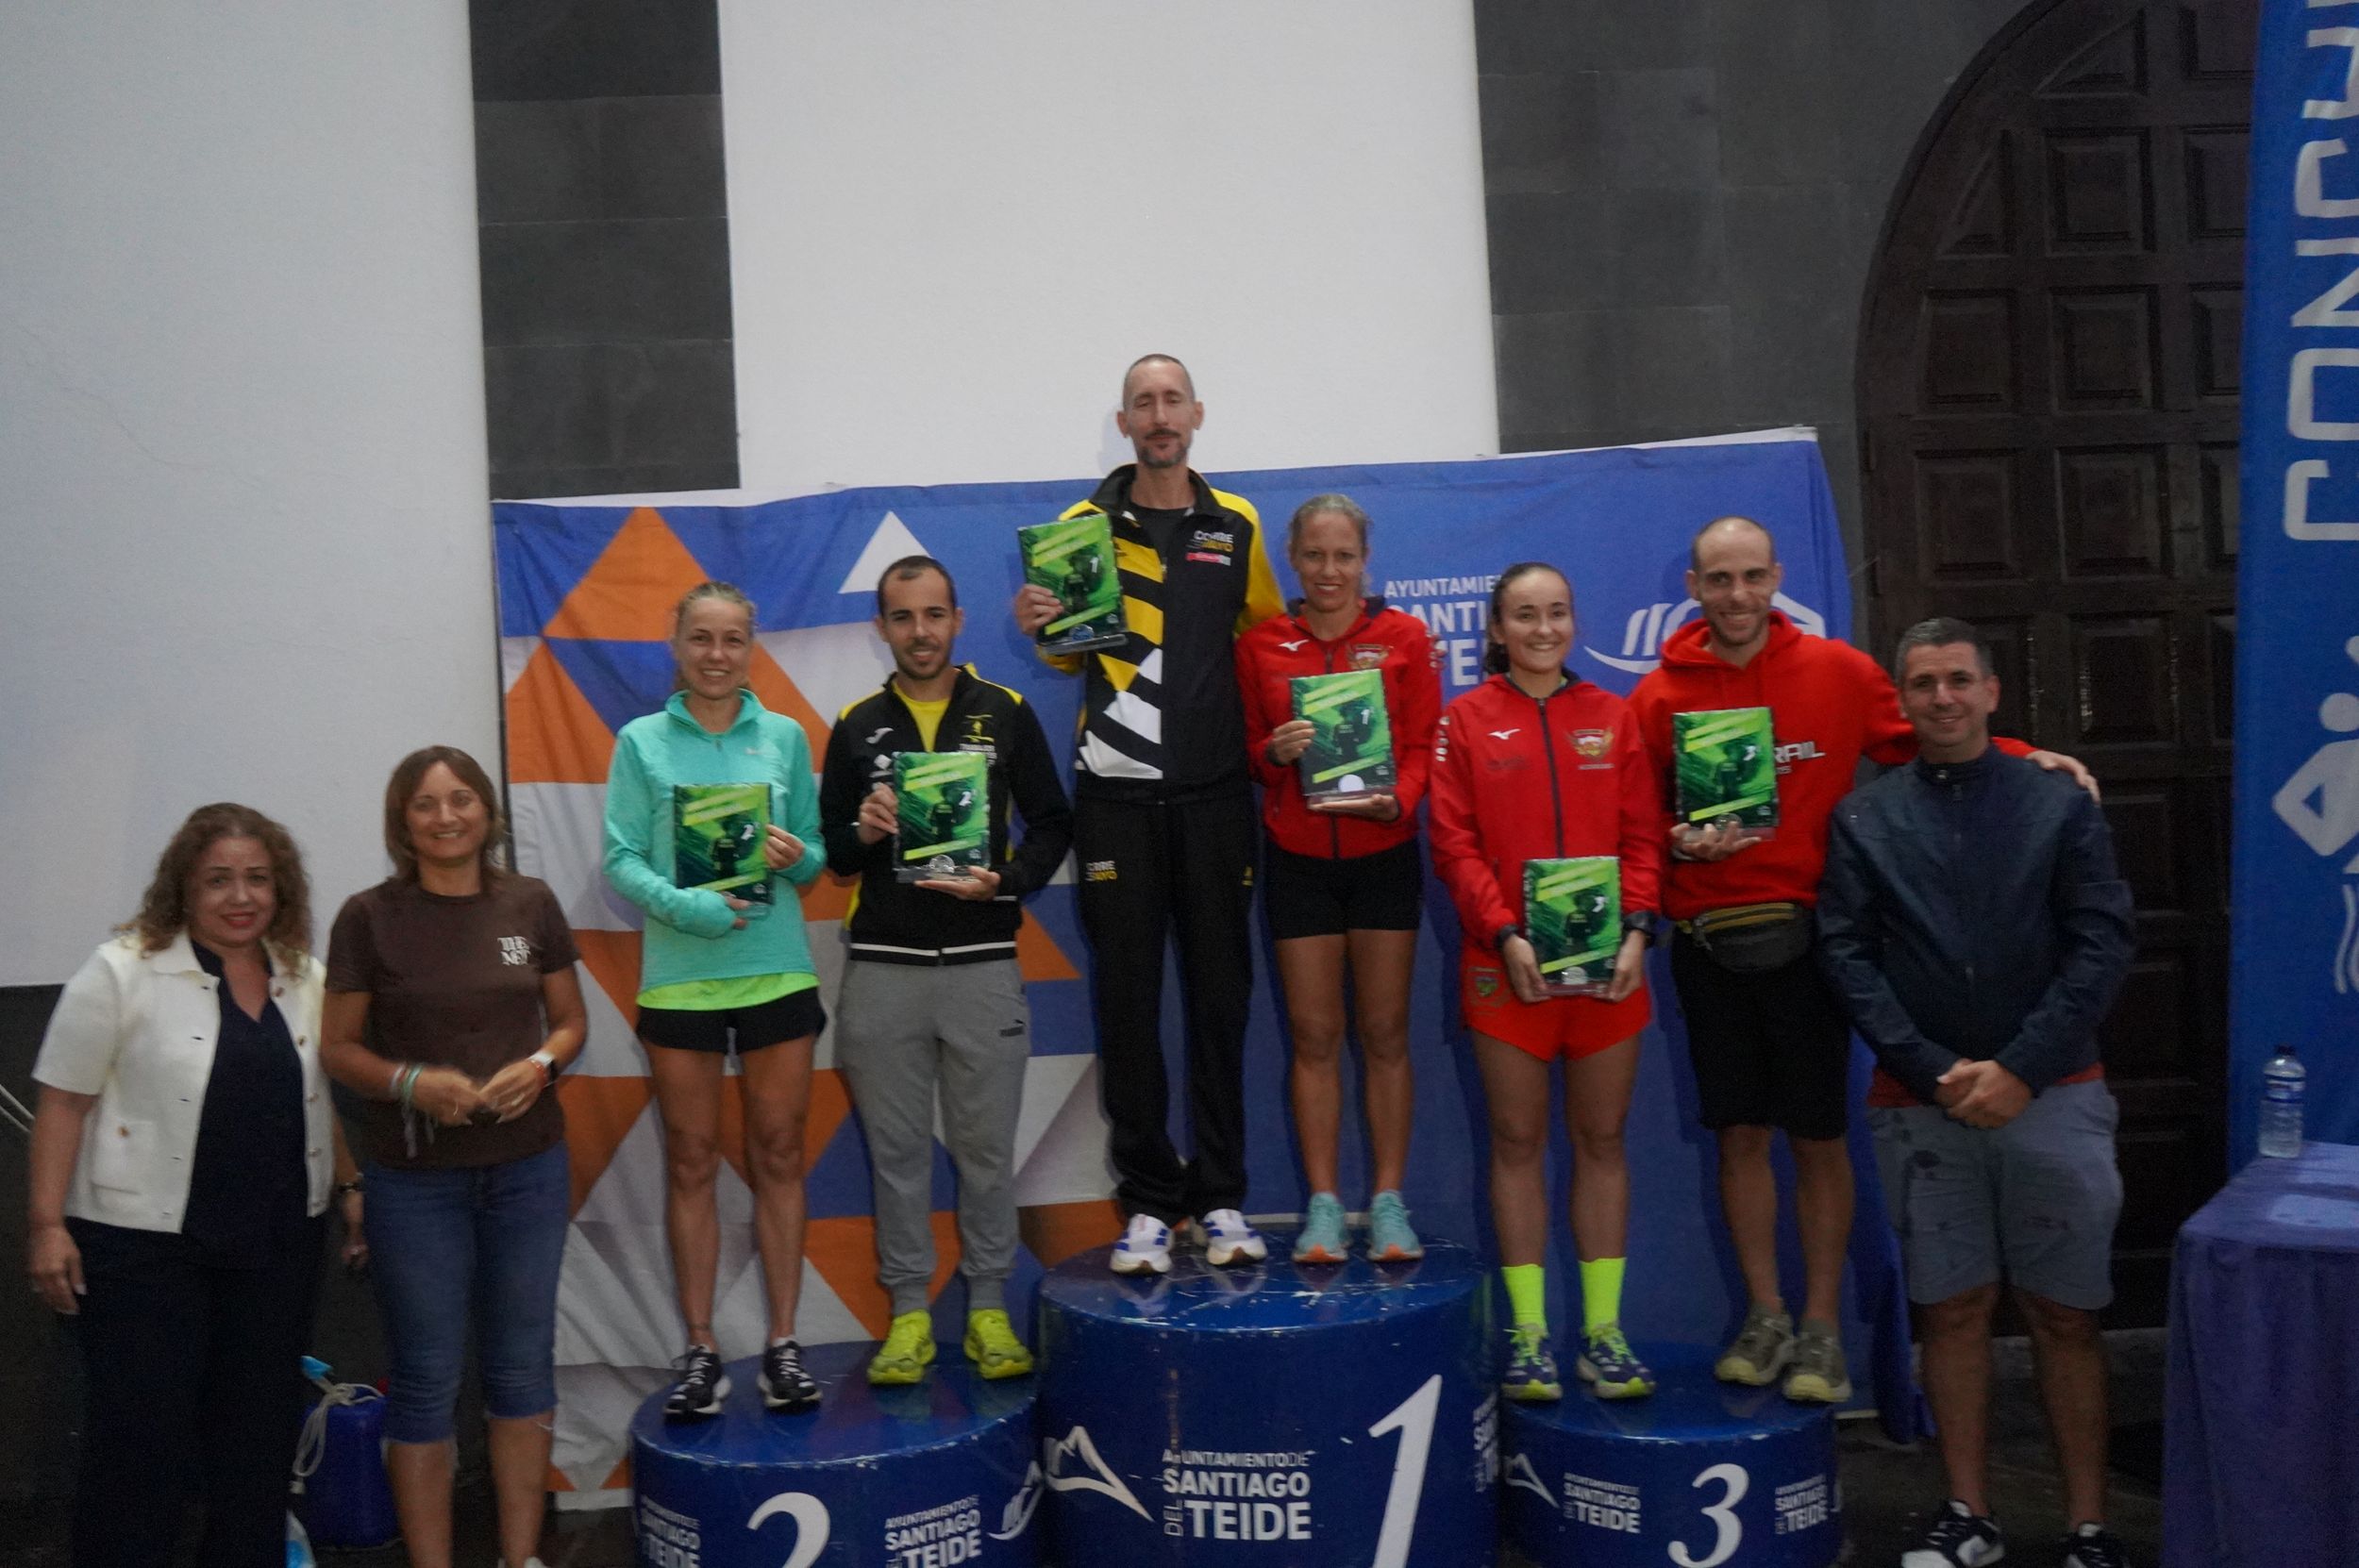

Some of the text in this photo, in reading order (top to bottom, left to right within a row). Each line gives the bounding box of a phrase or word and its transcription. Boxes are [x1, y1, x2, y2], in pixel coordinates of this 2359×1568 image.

[1383, 575, 1502, 598] AYUNTAMIE
[1162, 1468, 1312, 1498] SANTIAGO
[1368, 1374, 1443, 1568] 1
[746, 1492, 830, 1568] 2
[884, 1509, 981, 1551] SANTIAGO
[1163, 1499, 1184, 1537] DEL
[1184, 1499, 1313, 1541] TEIDE
[1573, 1500, 1642, 1534] TEIDE
[1667, 1463, 1749, 1568] 3
[901, 1528, 982, 1568] TEIDE
